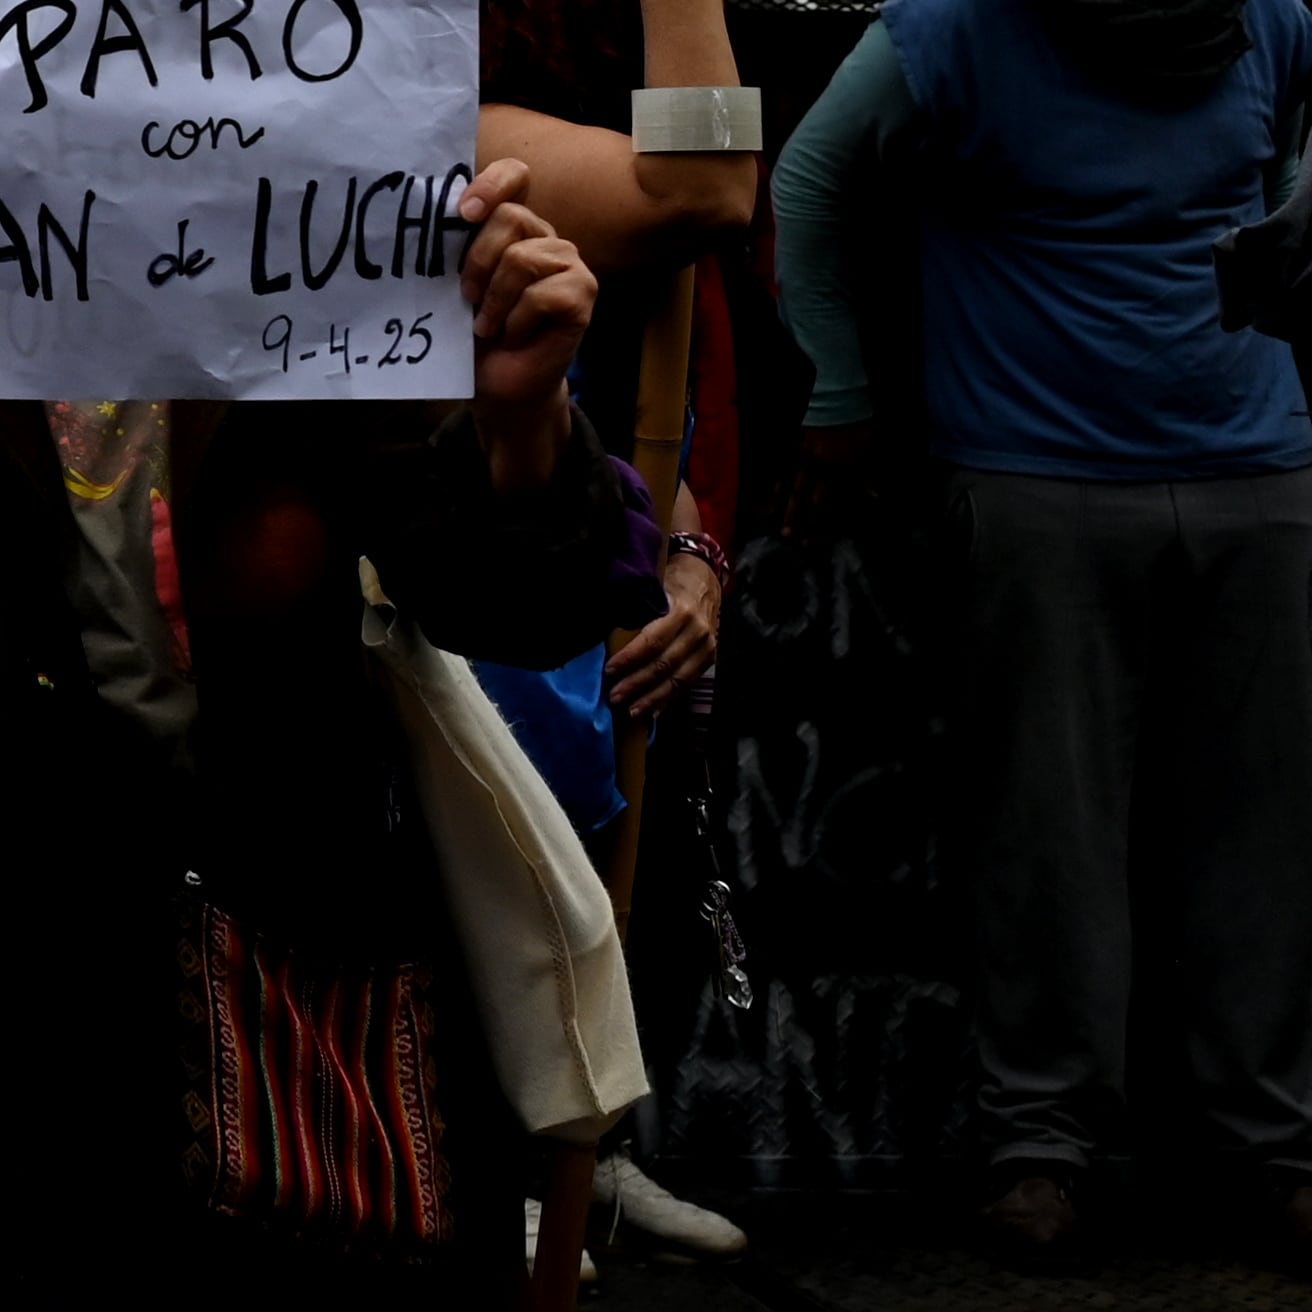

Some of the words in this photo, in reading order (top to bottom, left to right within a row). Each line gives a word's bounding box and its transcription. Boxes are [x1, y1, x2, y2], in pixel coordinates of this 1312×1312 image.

[141, 116, 264, 160] con
[146, 219, 216, 288] de
[250, 162, 481, 297] LUCHA
[261, 312, 433, 372] 9-4-25
